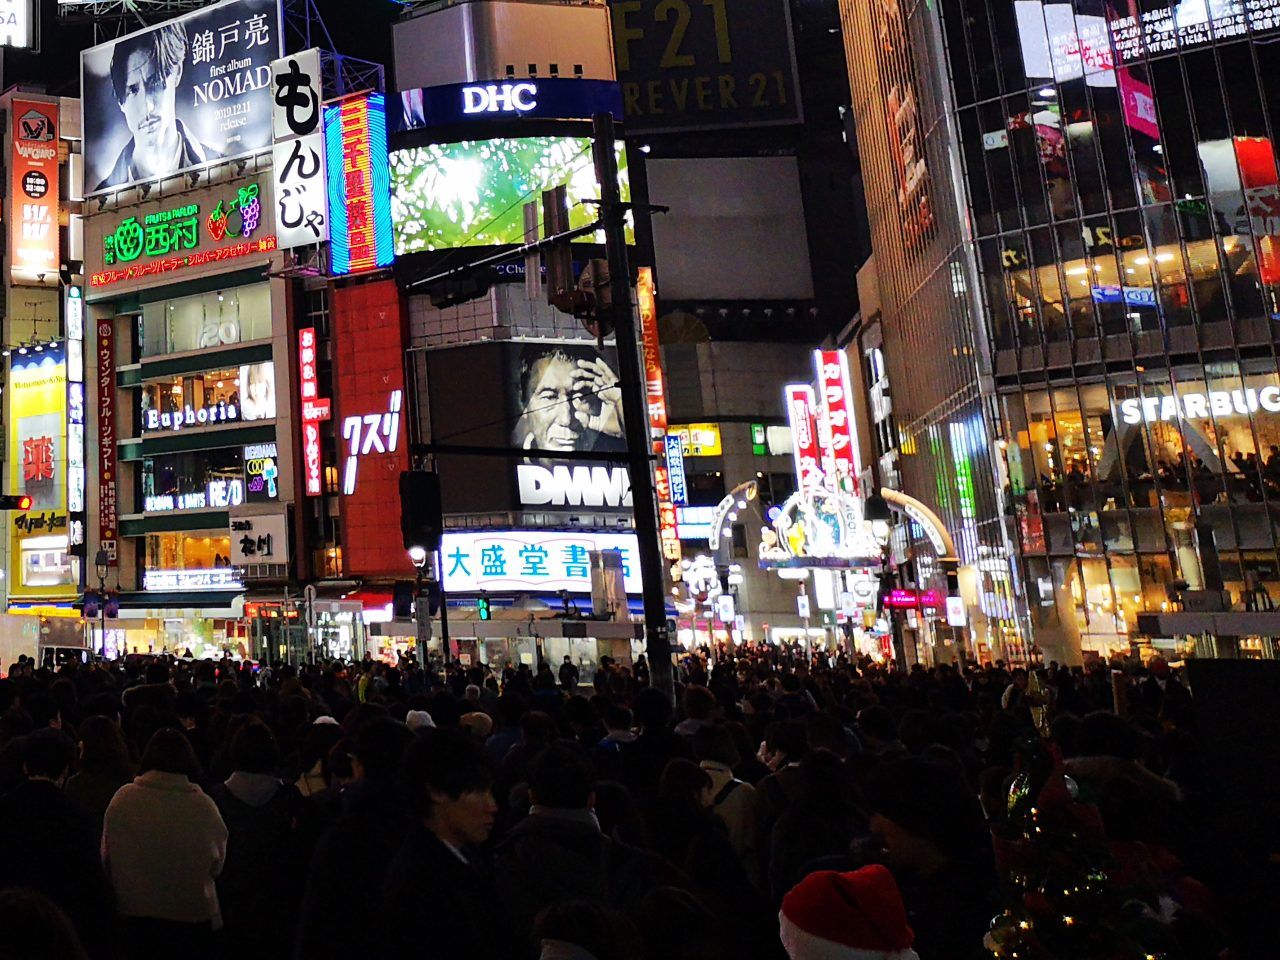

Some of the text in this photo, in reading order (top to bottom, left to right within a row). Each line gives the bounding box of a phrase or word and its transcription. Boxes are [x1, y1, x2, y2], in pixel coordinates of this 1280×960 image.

[192, 13, 270, 66] 錦戸亮
[193, 65, 272, 108] NOMAD
[209, 57, 252, 78] first album
[462, 83, 537, 113] DHC
[624, 70, 788, 116] REVER 21
[220, 117, 247, 132] release
[275, 59, 325, 238] もんじゃ
[145, 217, 199, 256] 西村
[100, 349, 112, 471] ウィンターフルーツギフト
[147, 400, 237, 430] Euphoria
[23, 435, 55, 482] 薬
